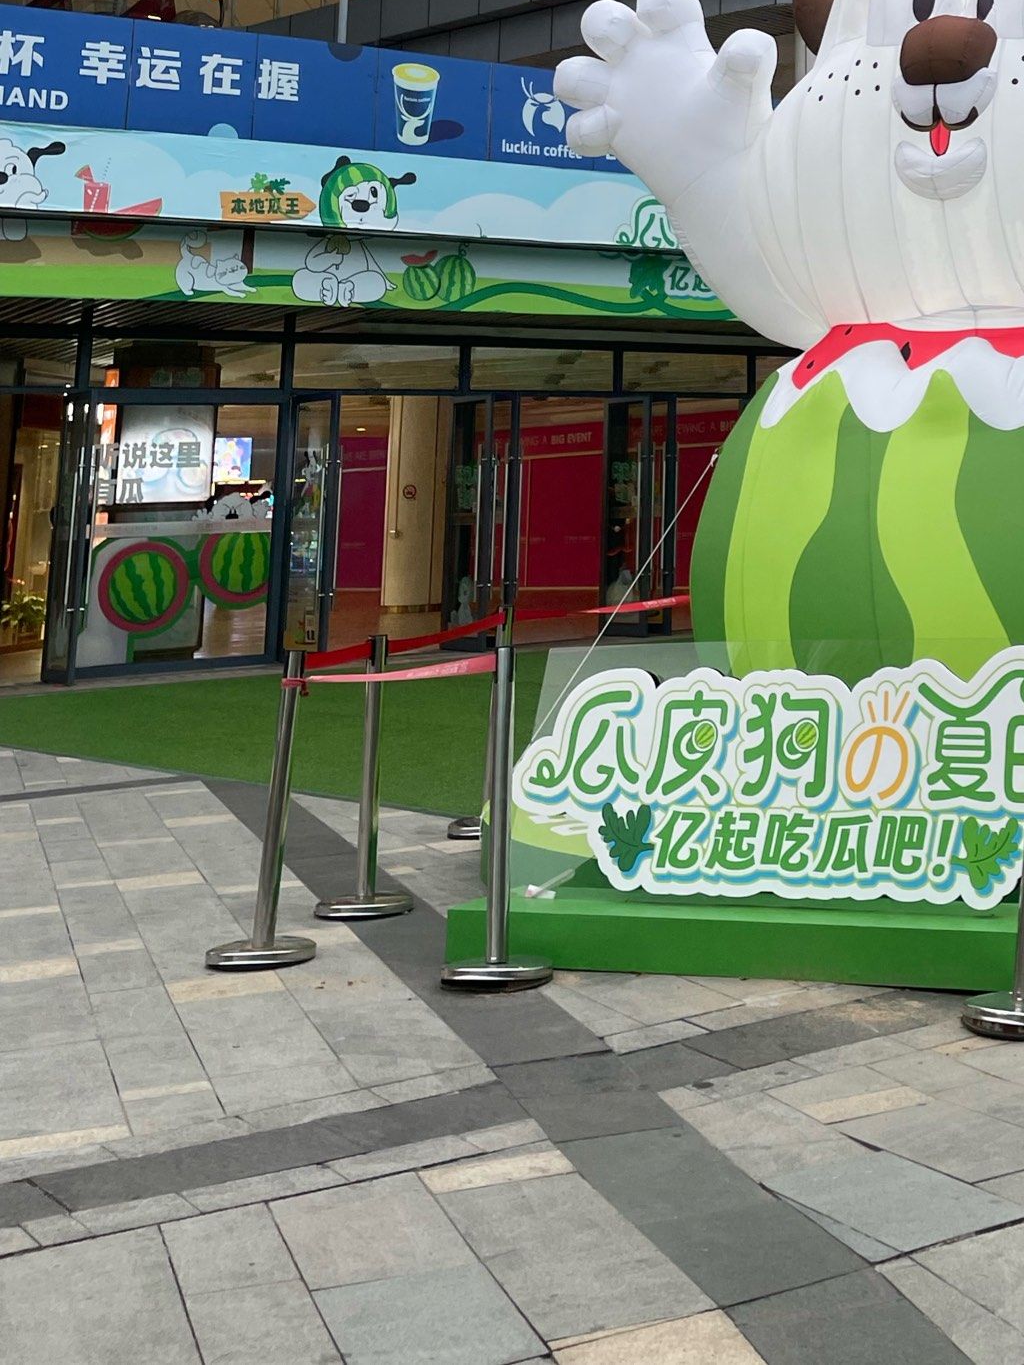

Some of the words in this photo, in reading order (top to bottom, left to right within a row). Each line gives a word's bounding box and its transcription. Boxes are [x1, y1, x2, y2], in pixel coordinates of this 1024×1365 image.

[0, 30, 45, 77] 杯
[79, 41, 300, 102] 幸运在握
[0, 87, 69, 111] AND
[502, 139, 540, 156] luckin
[231, 198, 300, 215] 本地瓜王
[567, 431, 593, 444] EVENT
[651, 809, 960, 881] 亿起吃瓜吧!
